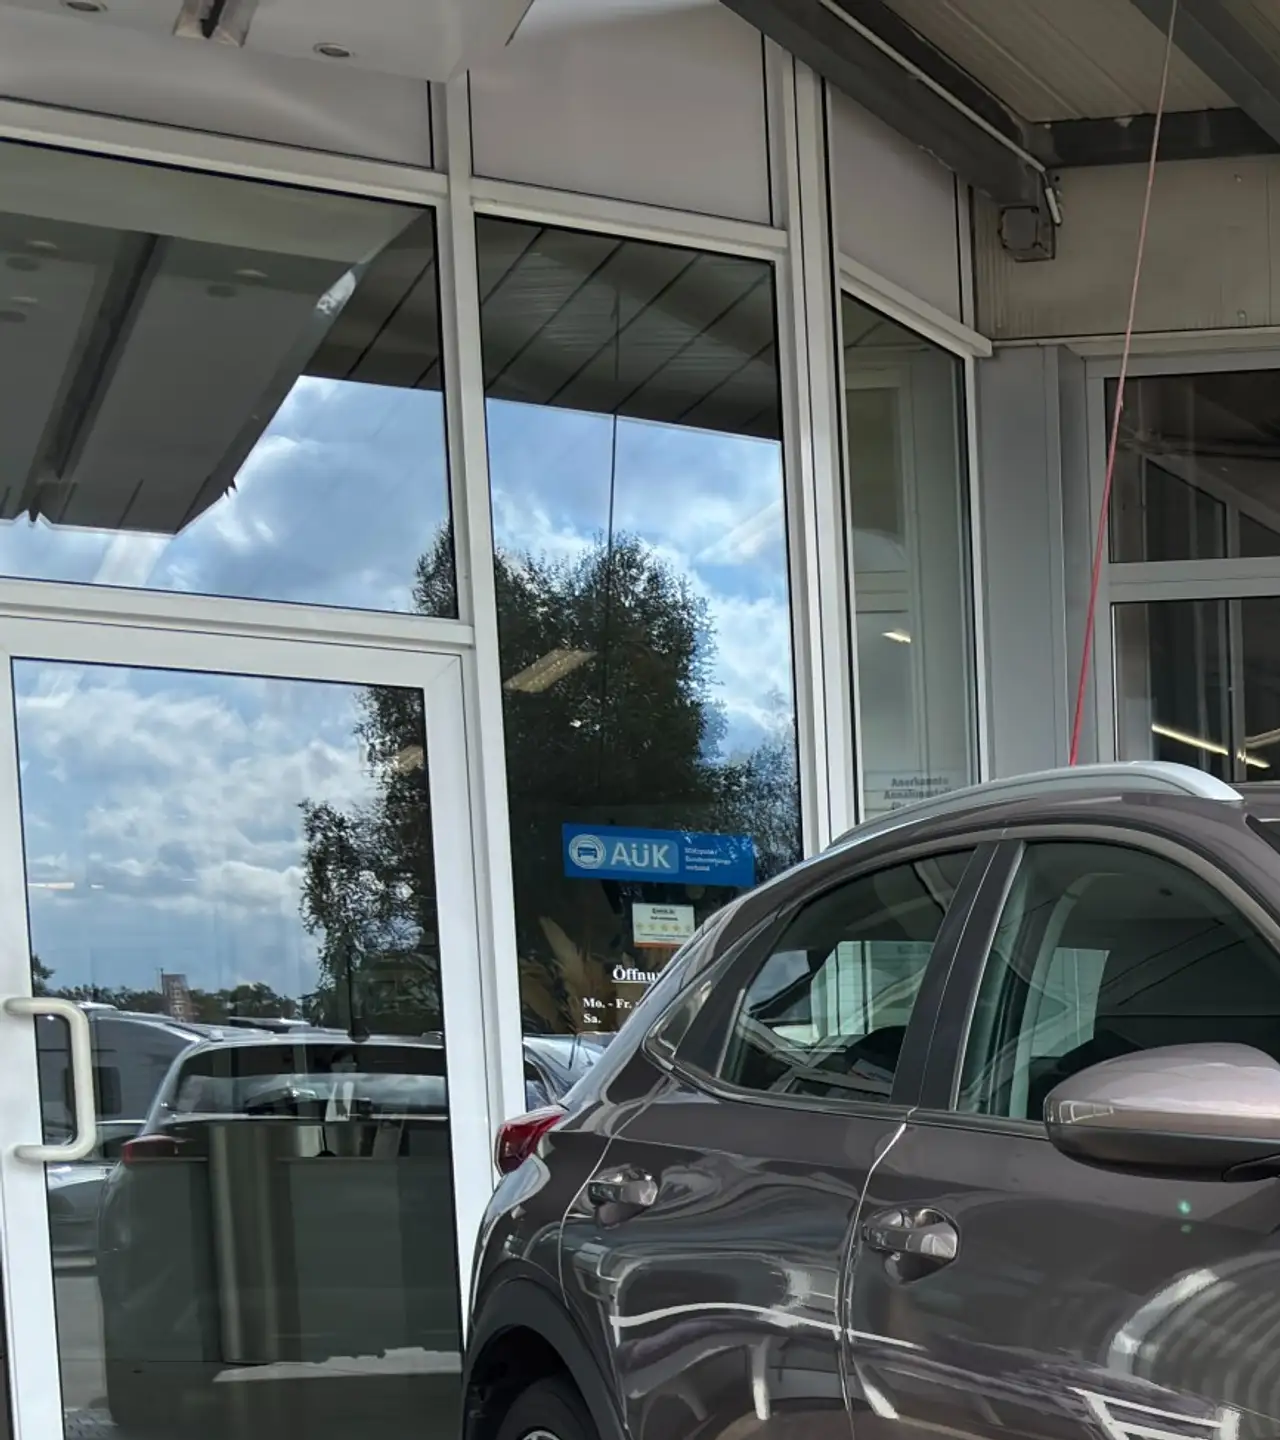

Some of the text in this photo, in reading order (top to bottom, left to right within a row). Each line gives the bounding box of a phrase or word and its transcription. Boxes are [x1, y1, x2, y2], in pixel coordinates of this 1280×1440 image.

[583, 997, 605, 1008] Mo.
[616, 999, 632, 1008] Fr.
[583, 1013, 601, 1023] Sa.
